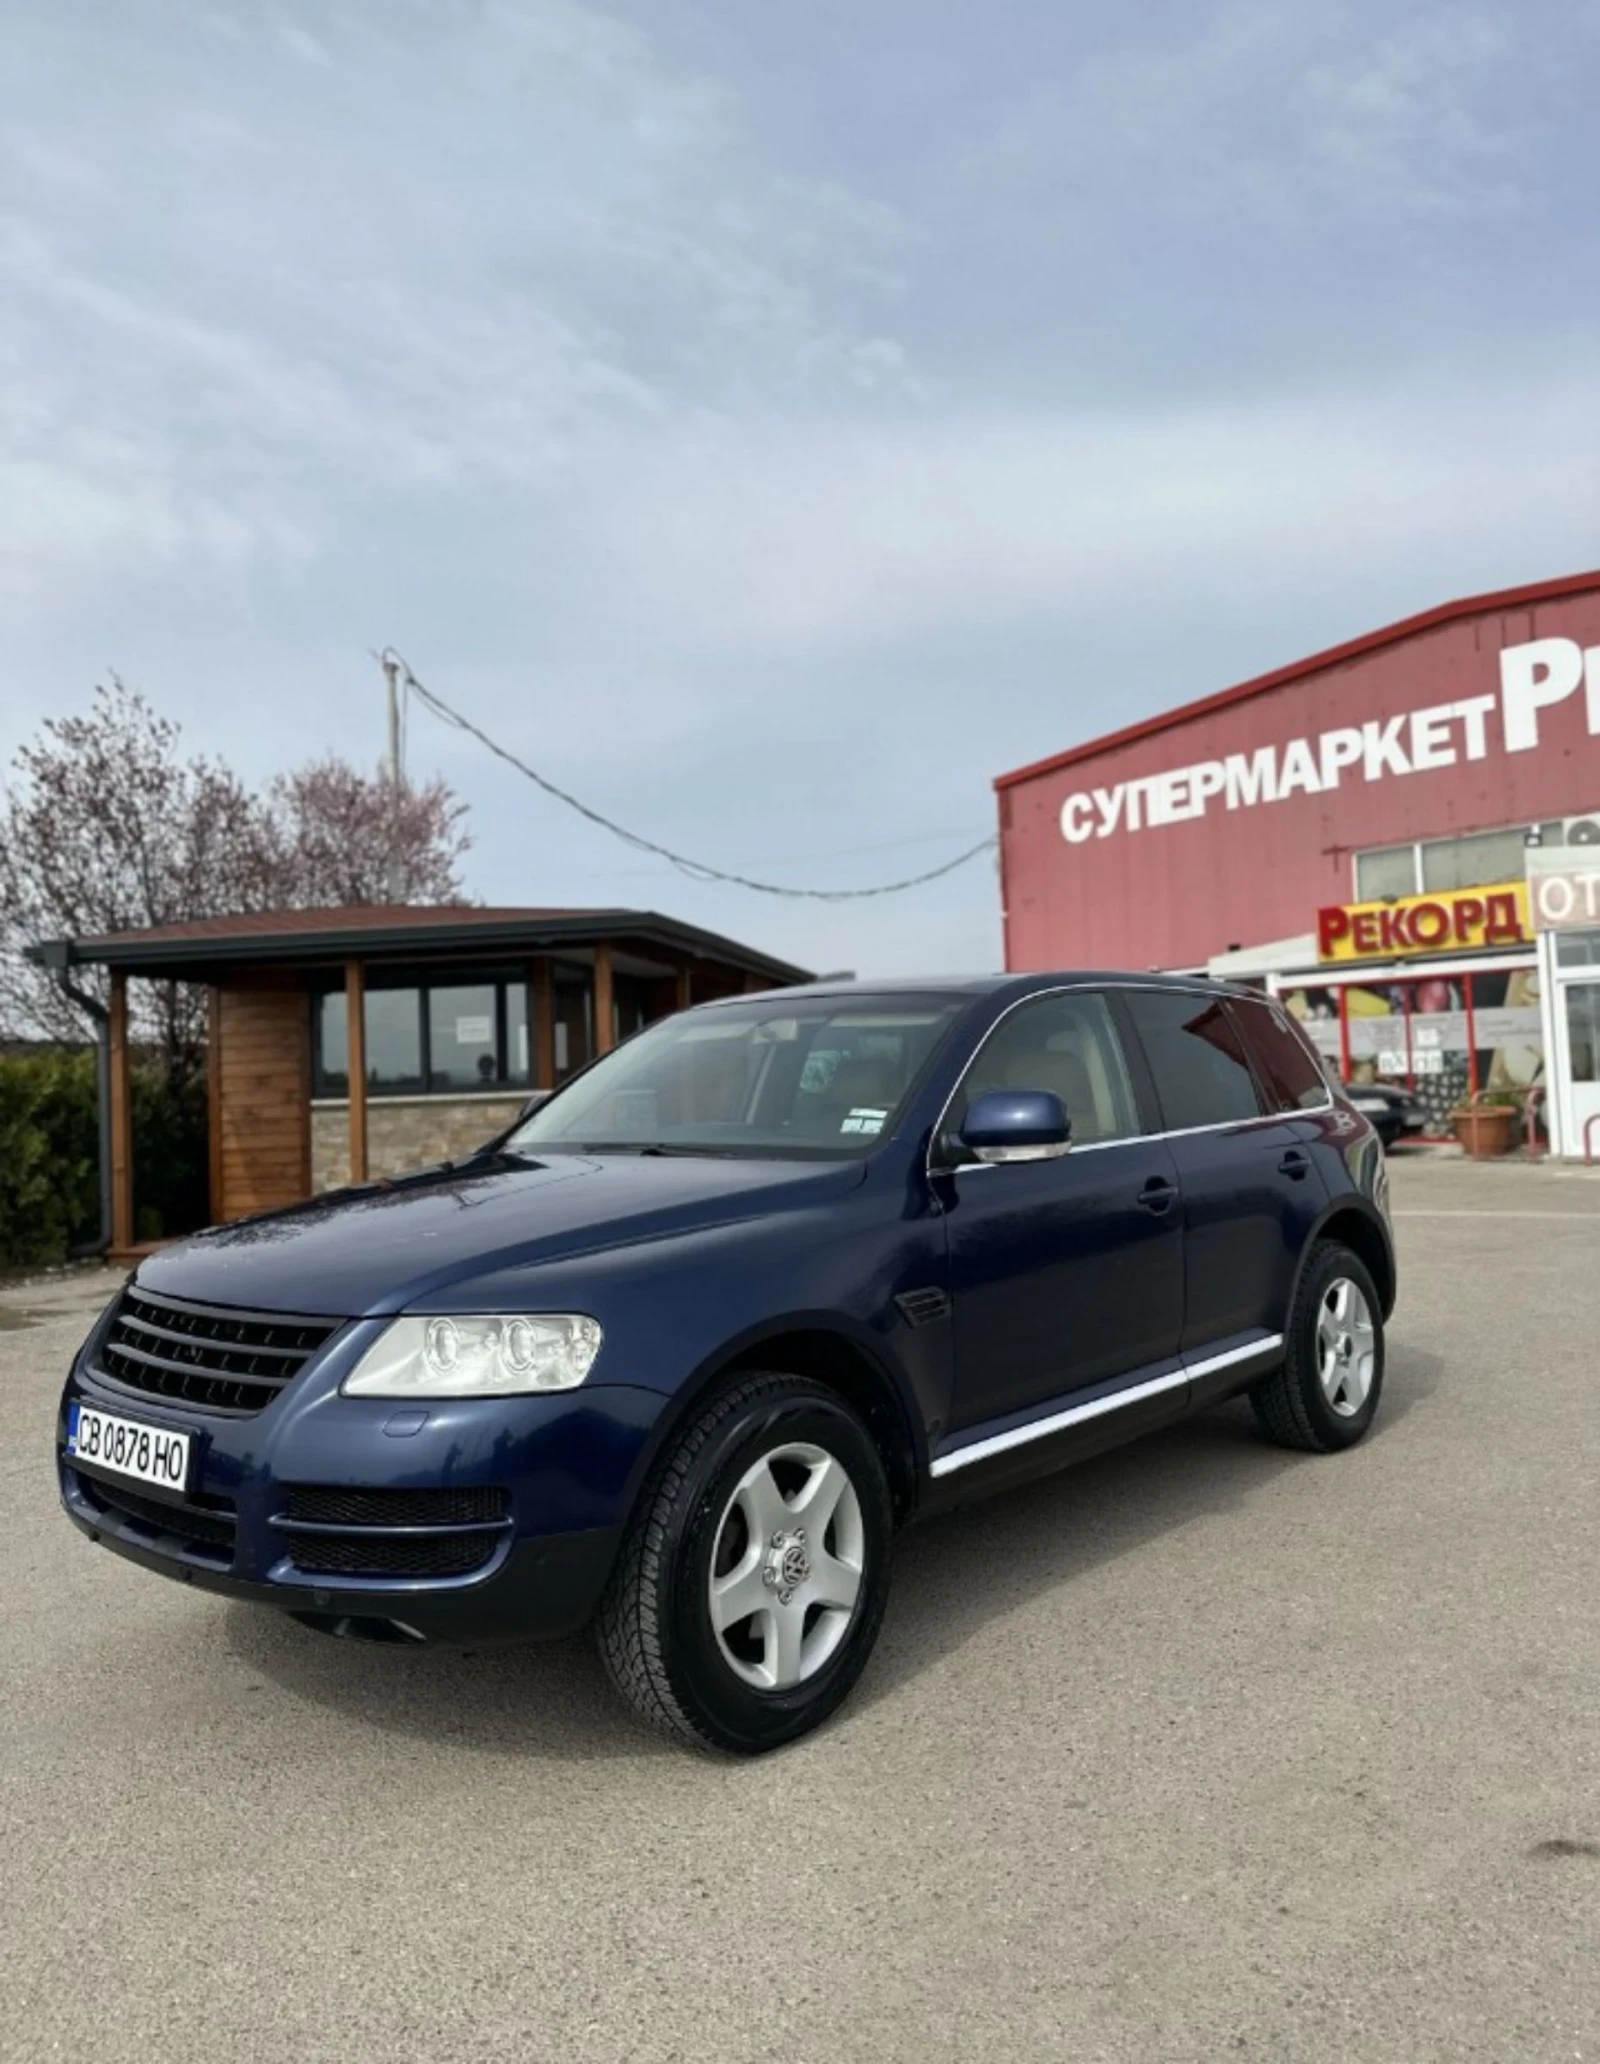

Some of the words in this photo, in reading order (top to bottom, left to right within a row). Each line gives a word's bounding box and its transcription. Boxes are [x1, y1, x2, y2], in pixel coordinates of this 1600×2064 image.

[1060, 693, 1496, 844] СУПЕРМАРКЕТ
[1500, 637, 1600, 754] Р
[1317, 893, 1524, 957] РЕКОРД
[104, 1421, 150, 1473] 0878
